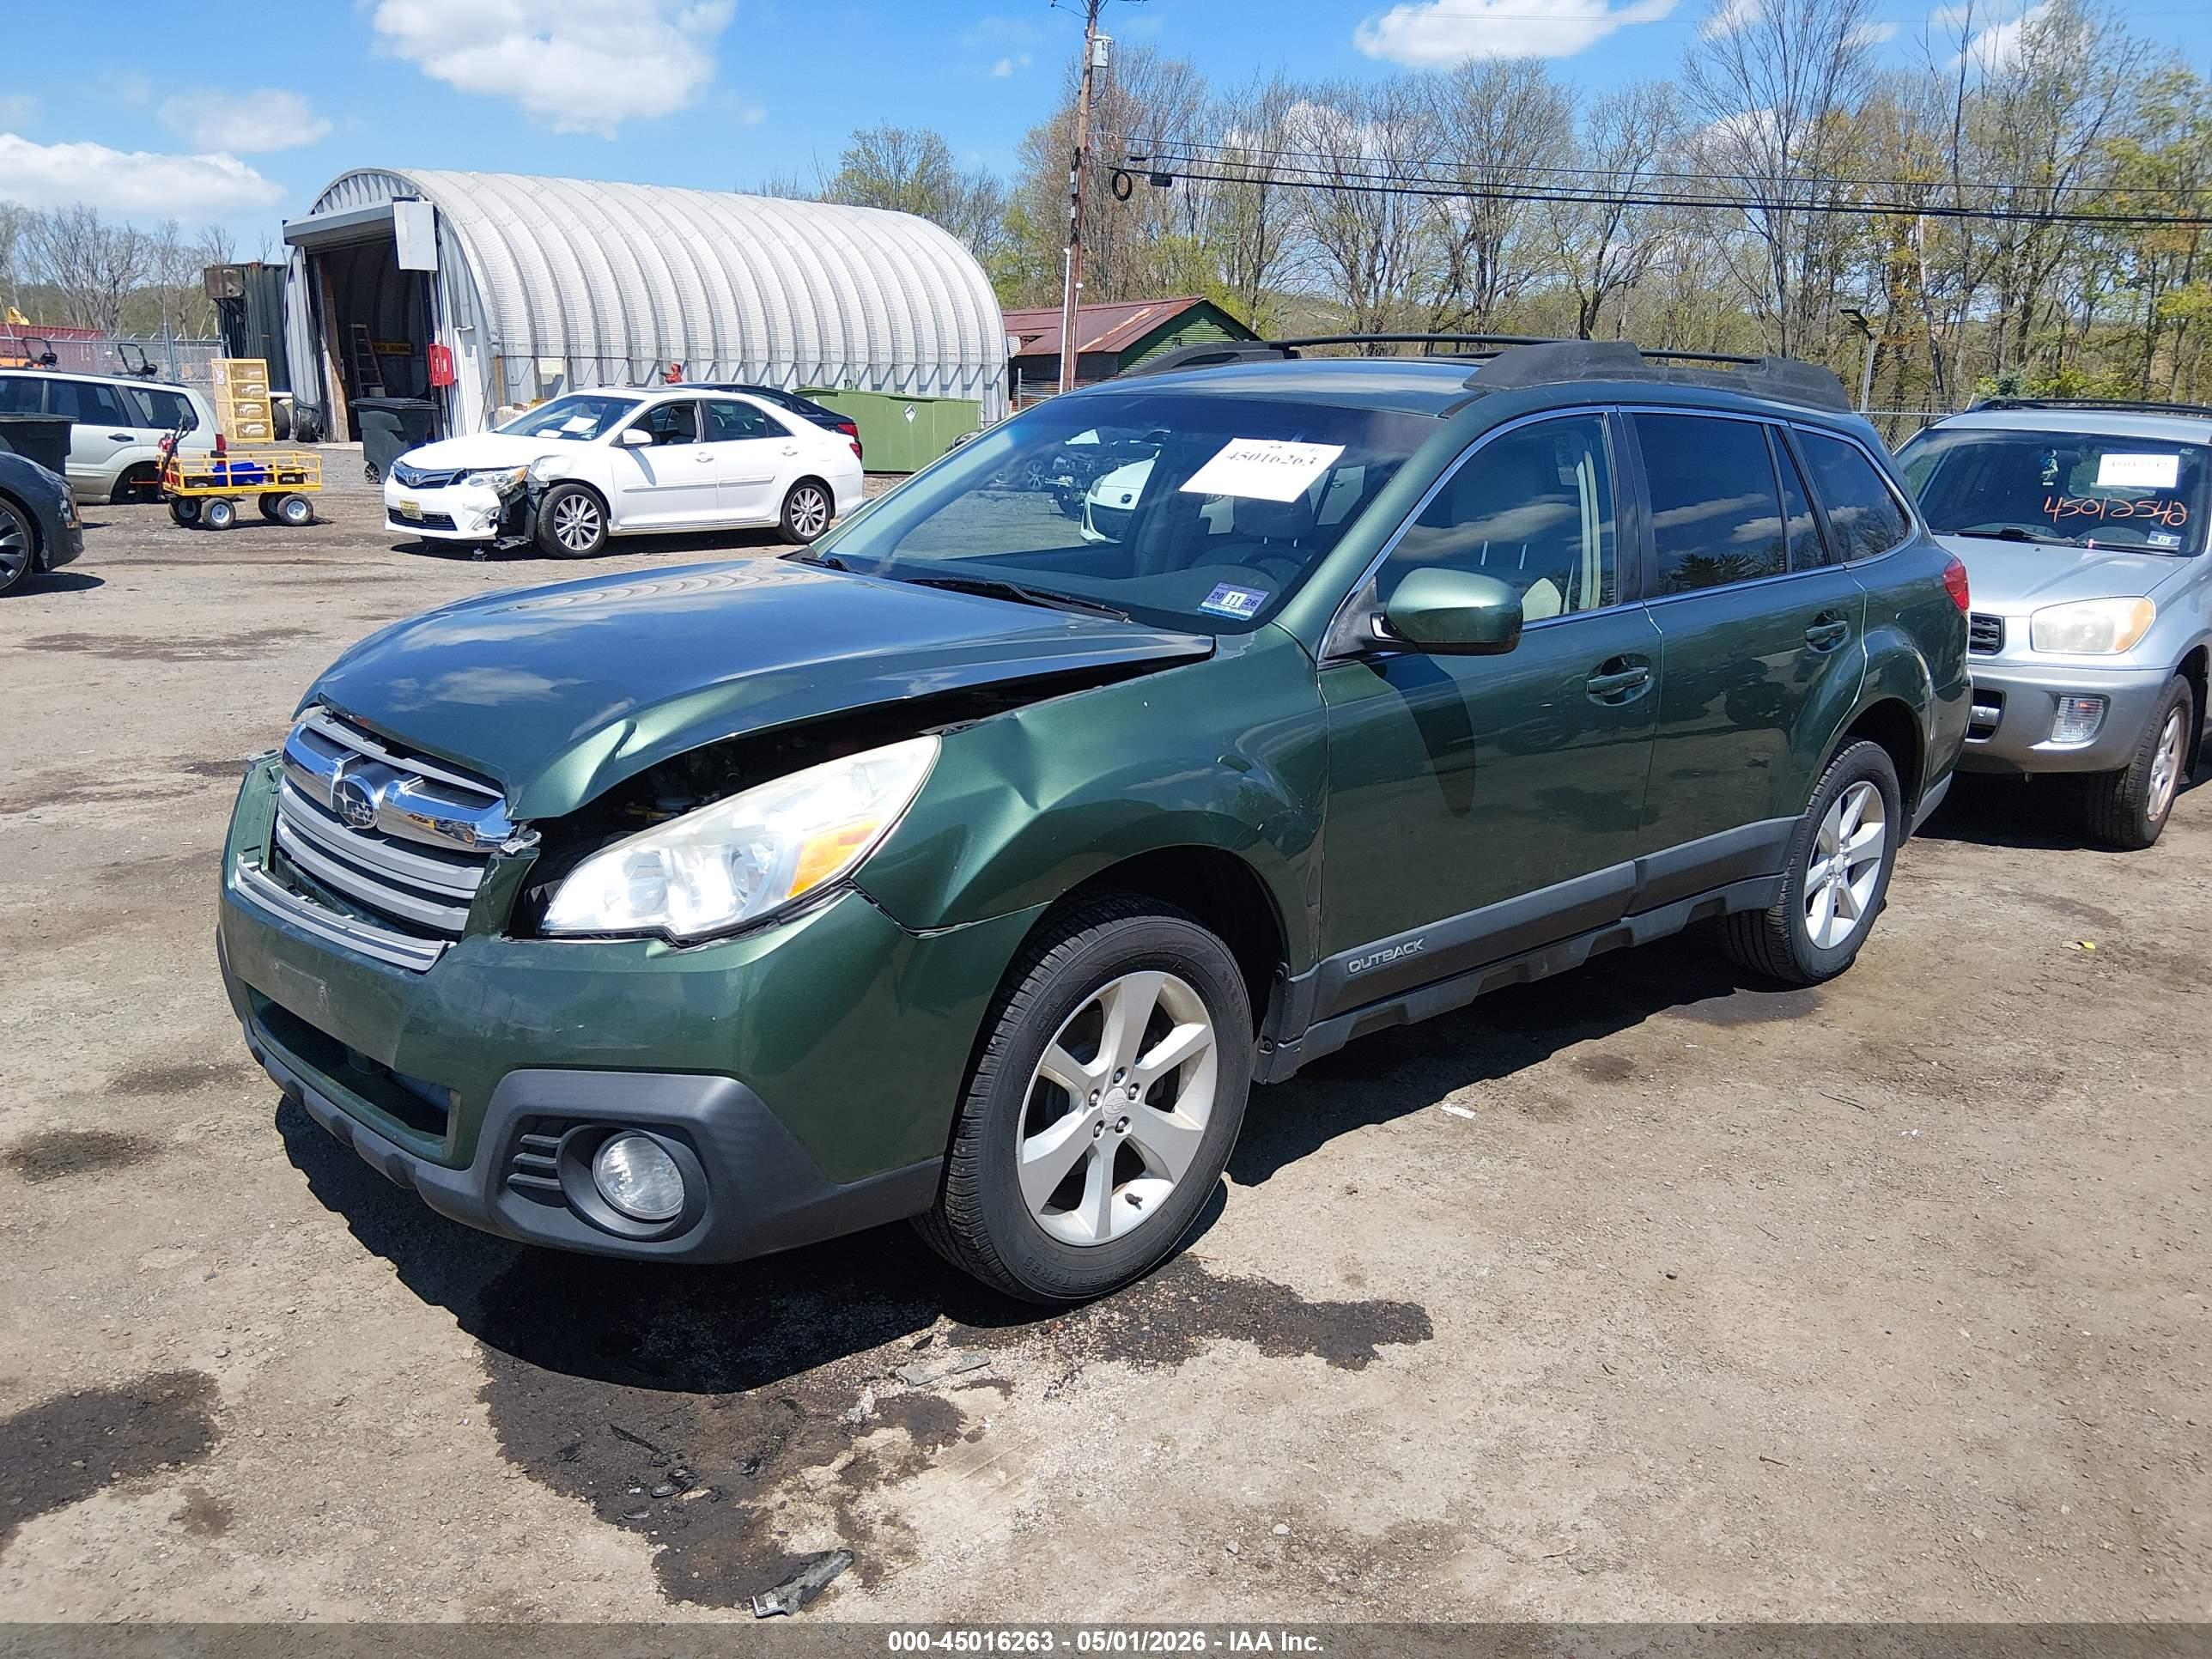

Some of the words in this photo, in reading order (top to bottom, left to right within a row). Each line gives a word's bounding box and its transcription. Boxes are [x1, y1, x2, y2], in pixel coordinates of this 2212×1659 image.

[2044, 495, 2188, 526] 45012542
[1225, 594, 1242, 606] 11
[1348, 938, 1425, 974] OUTBACK
